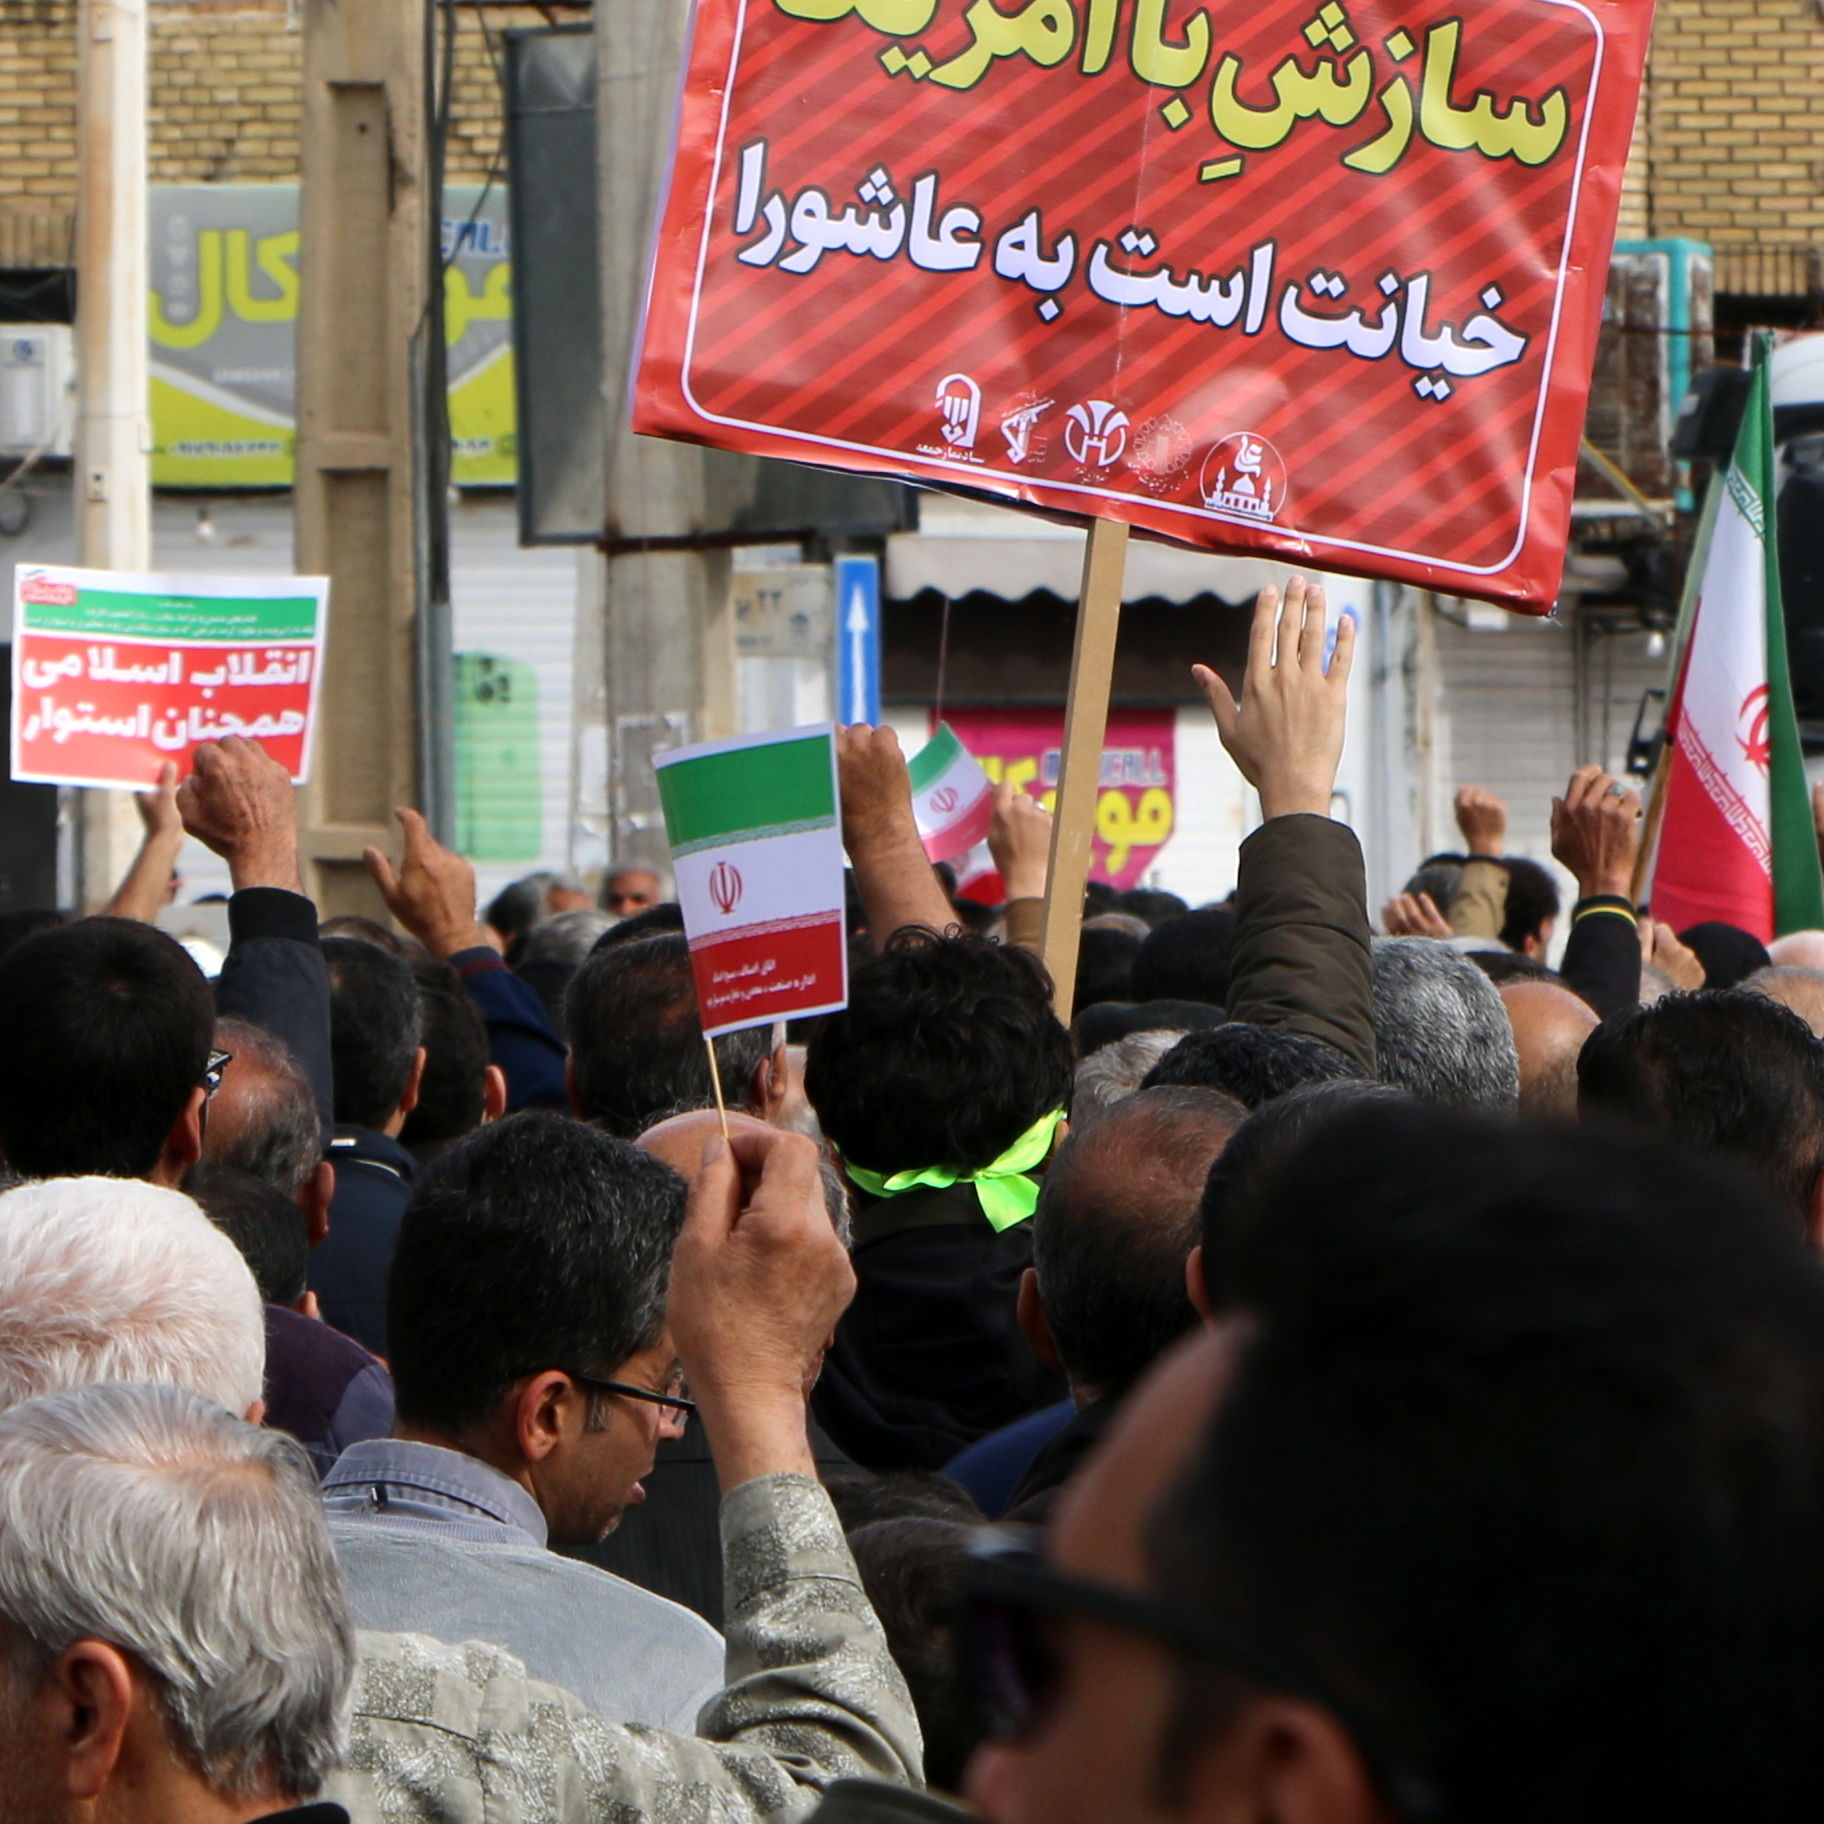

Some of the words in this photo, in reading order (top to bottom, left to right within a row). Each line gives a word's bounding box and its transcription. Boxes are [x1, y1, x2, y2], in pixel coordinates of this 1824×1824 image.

[732, 139, 982, 274] عاشورا
[992, 205, 1078, 323] به
[1085, 224, 1276, 336] است
[1277, 267, 1529, 399] خیانت
[22, 646, 183, 690] اسلامی
[22, 696, 152, 744] استوار
[189, 648, 312, 700] انقلاب
